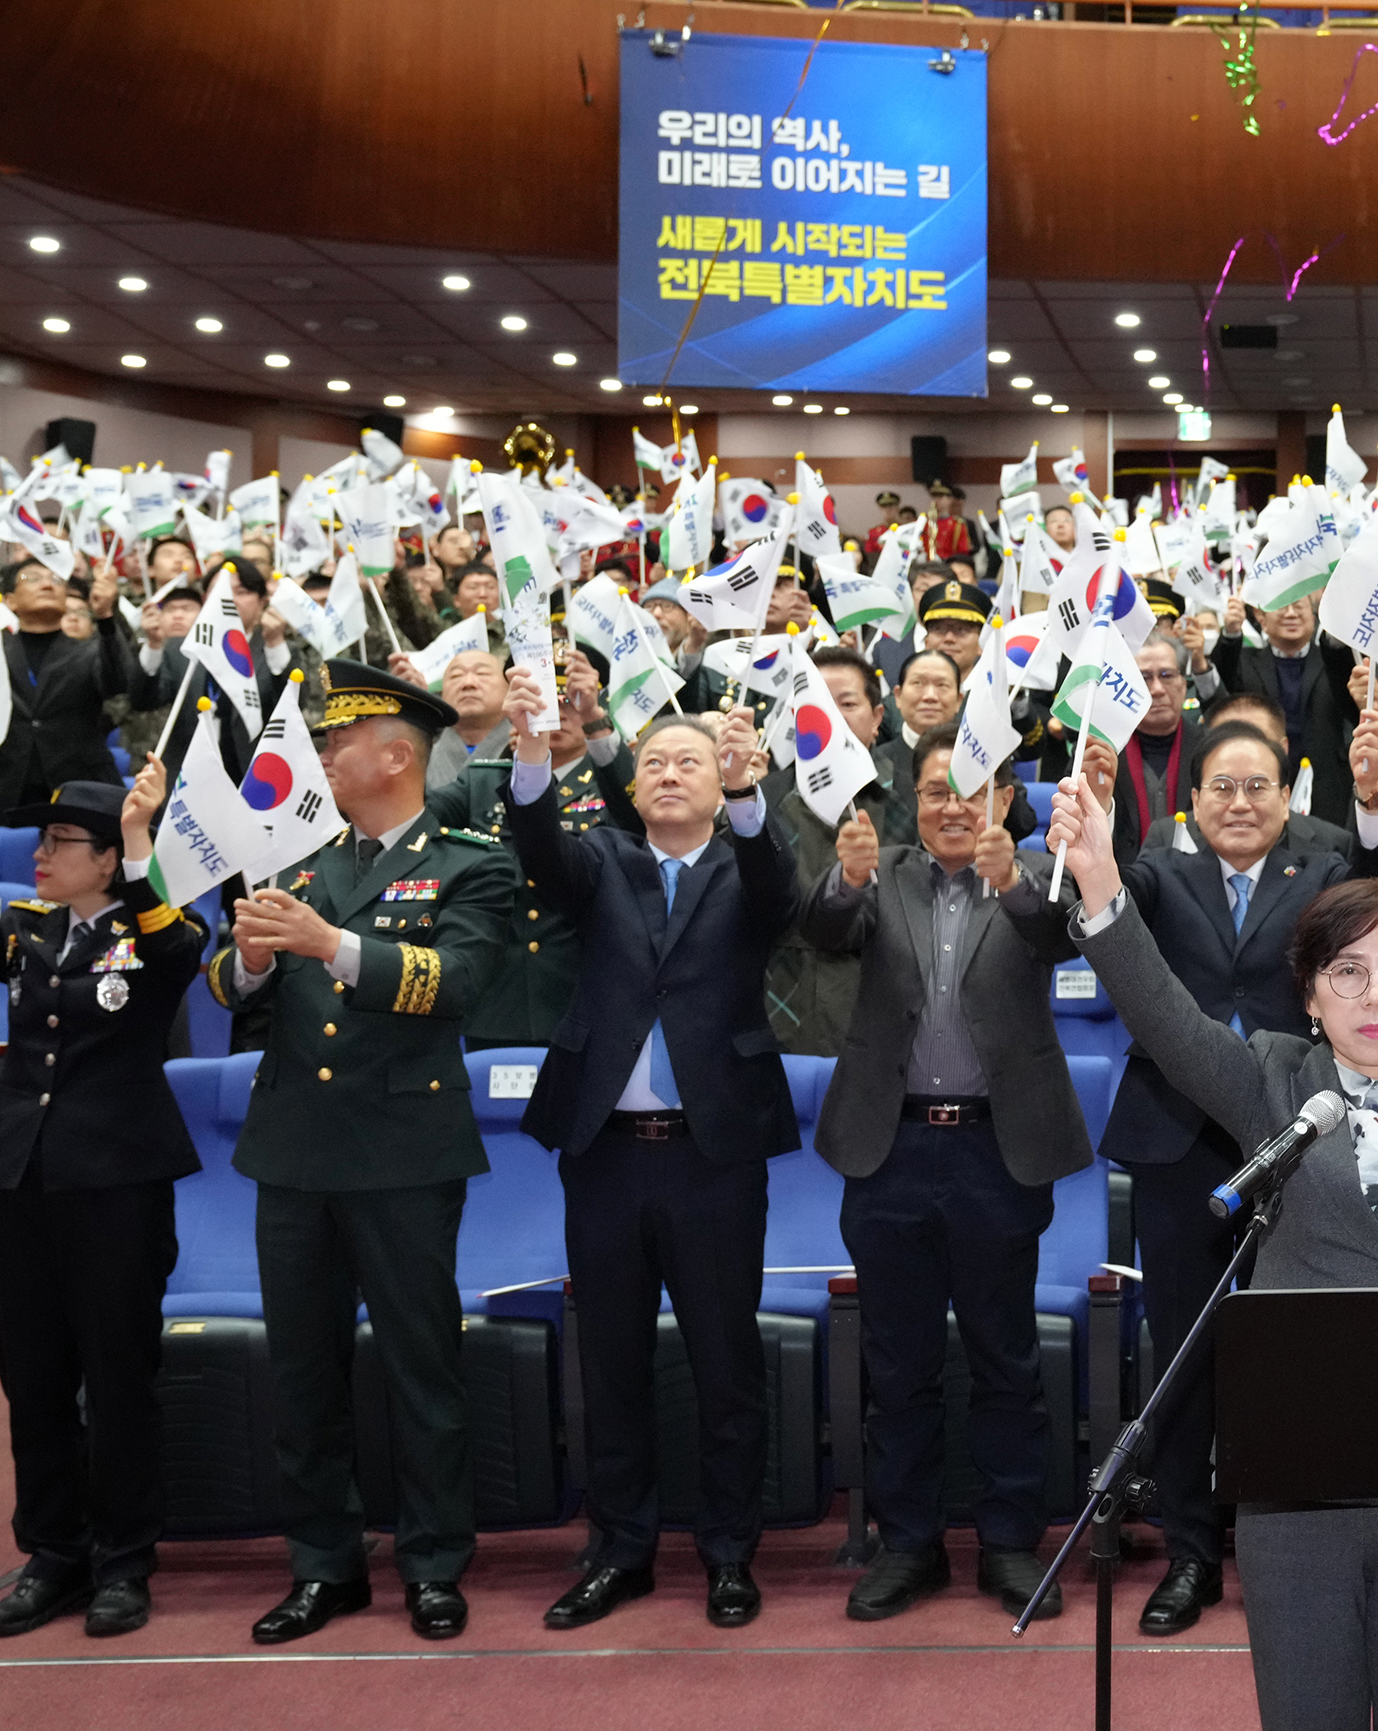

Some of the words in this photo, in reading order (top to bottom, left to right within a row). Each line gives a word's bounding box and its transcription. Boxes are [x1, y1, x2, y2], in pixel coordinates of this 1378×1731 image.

[658, 110, 762, 149] 우리의
[771, 116, 850, 157] 역사,
[658, 151, 763, 189] 미래로
[771, 156, 908, 198] 이어지는
[917, 164, 951, 200] 길
[656, 215, 763, 253] 새롭게
[770, 221, 907, 260] 시작되는
[658, 258, 948, 310] 전북특별자치도
